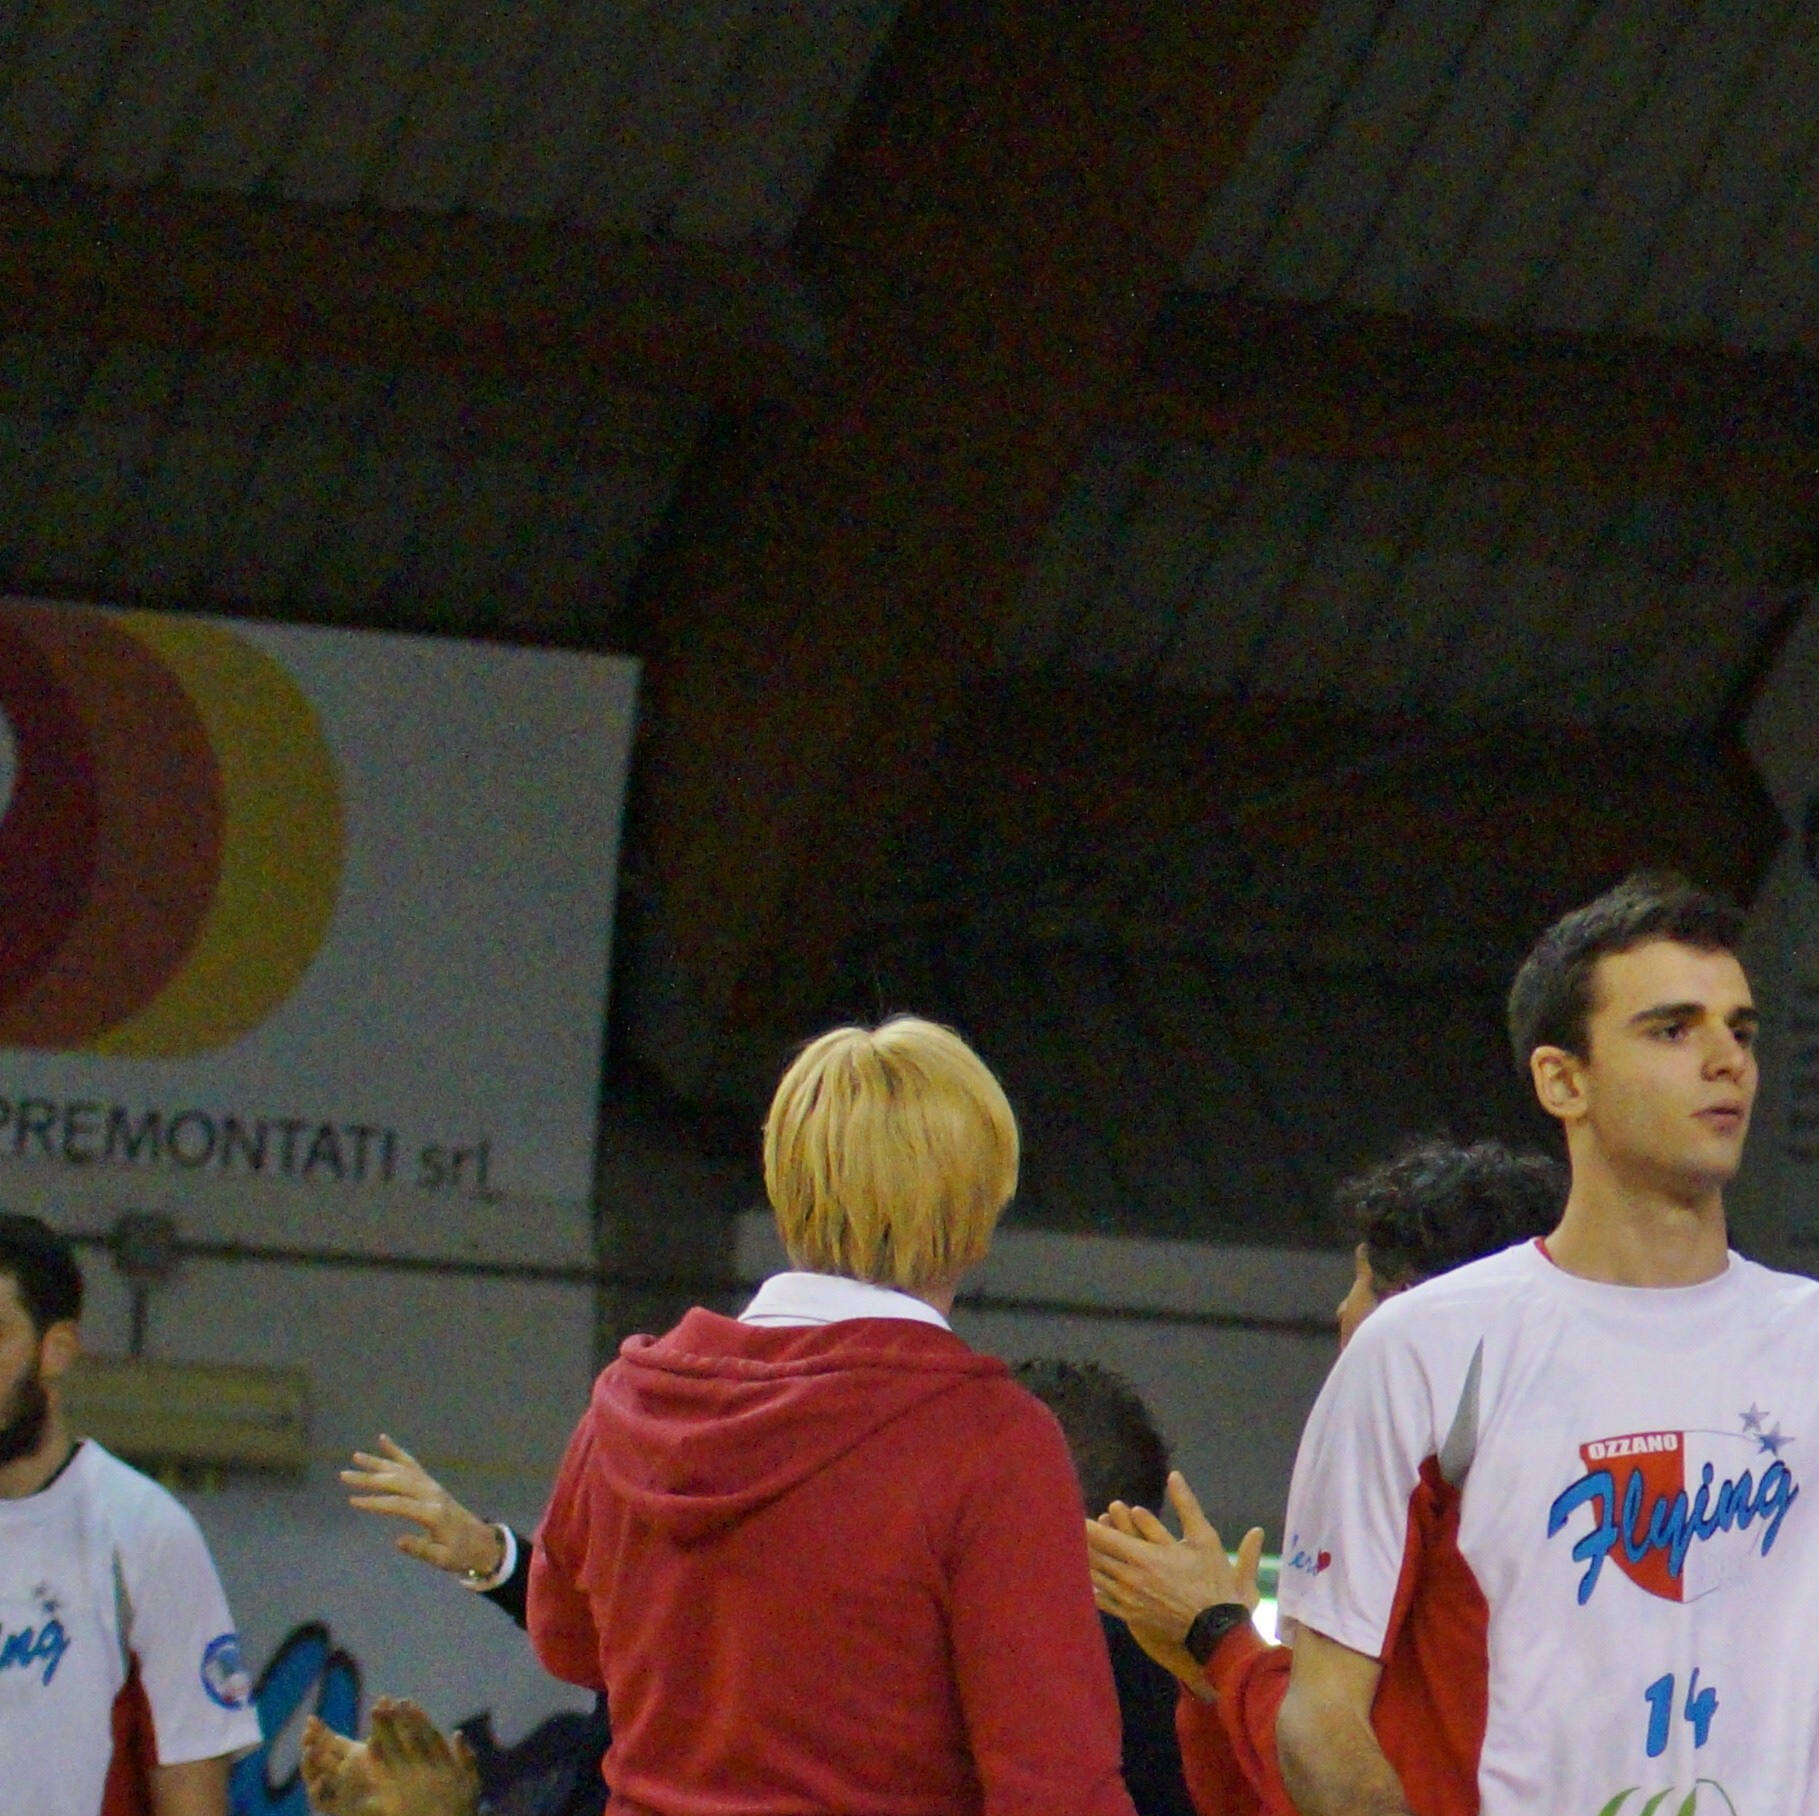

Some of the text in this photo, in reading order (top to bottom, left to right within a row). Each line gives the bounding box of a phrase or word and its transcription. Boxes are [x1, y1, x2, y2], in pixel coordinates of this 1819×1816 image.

[1587, 1432, 1679, 1461] OZZANO
[1547, 1459, 1799, 1606] Flying
[1644, 1666, 1720, 1758] 14
